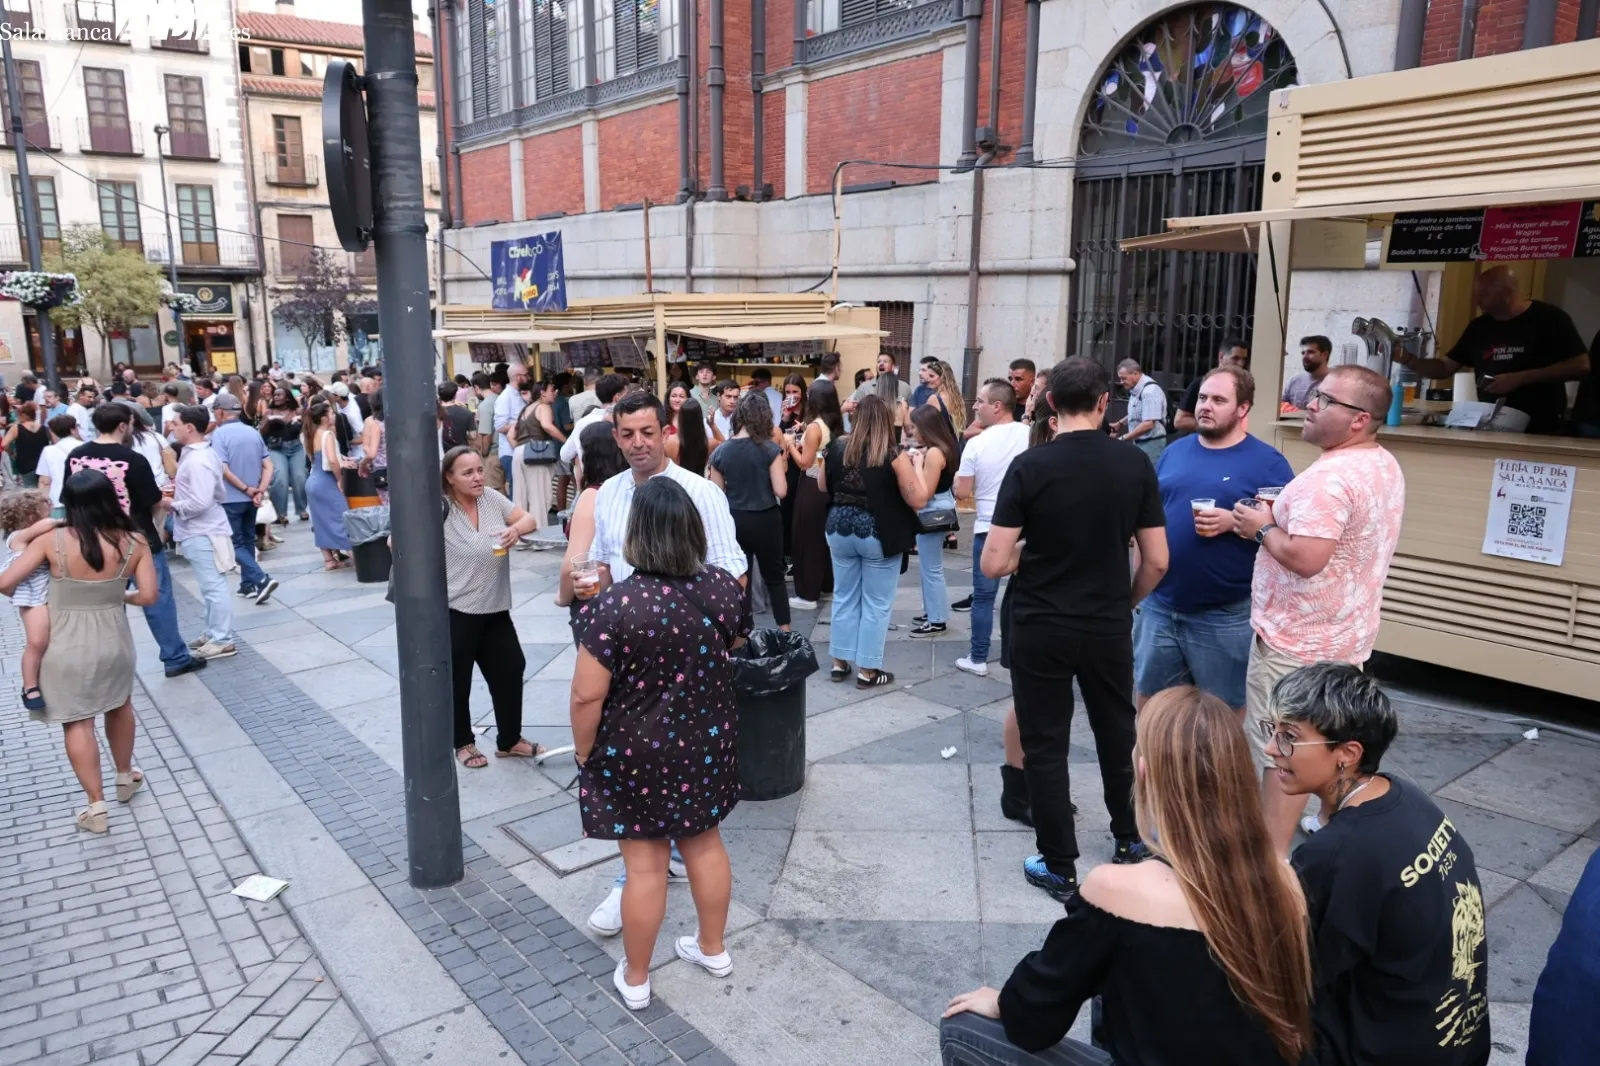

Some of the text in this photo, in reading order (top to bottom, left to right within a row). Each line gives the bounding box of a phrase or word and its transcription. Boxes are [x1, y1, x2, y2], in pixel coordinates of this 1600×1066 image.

[1414, 224, 1443, 233] pinchos
[1512, 221, 1537, 230] burger
[1551, 220, 1569, 228] Buey
[1500, 461, 1528, 474] FERIA
[1533, 465, 1546, 475] DE
[1498, 471, 1567, 489] SALAMANCA
[1400, 814, 1457, 888] SOCIETY
